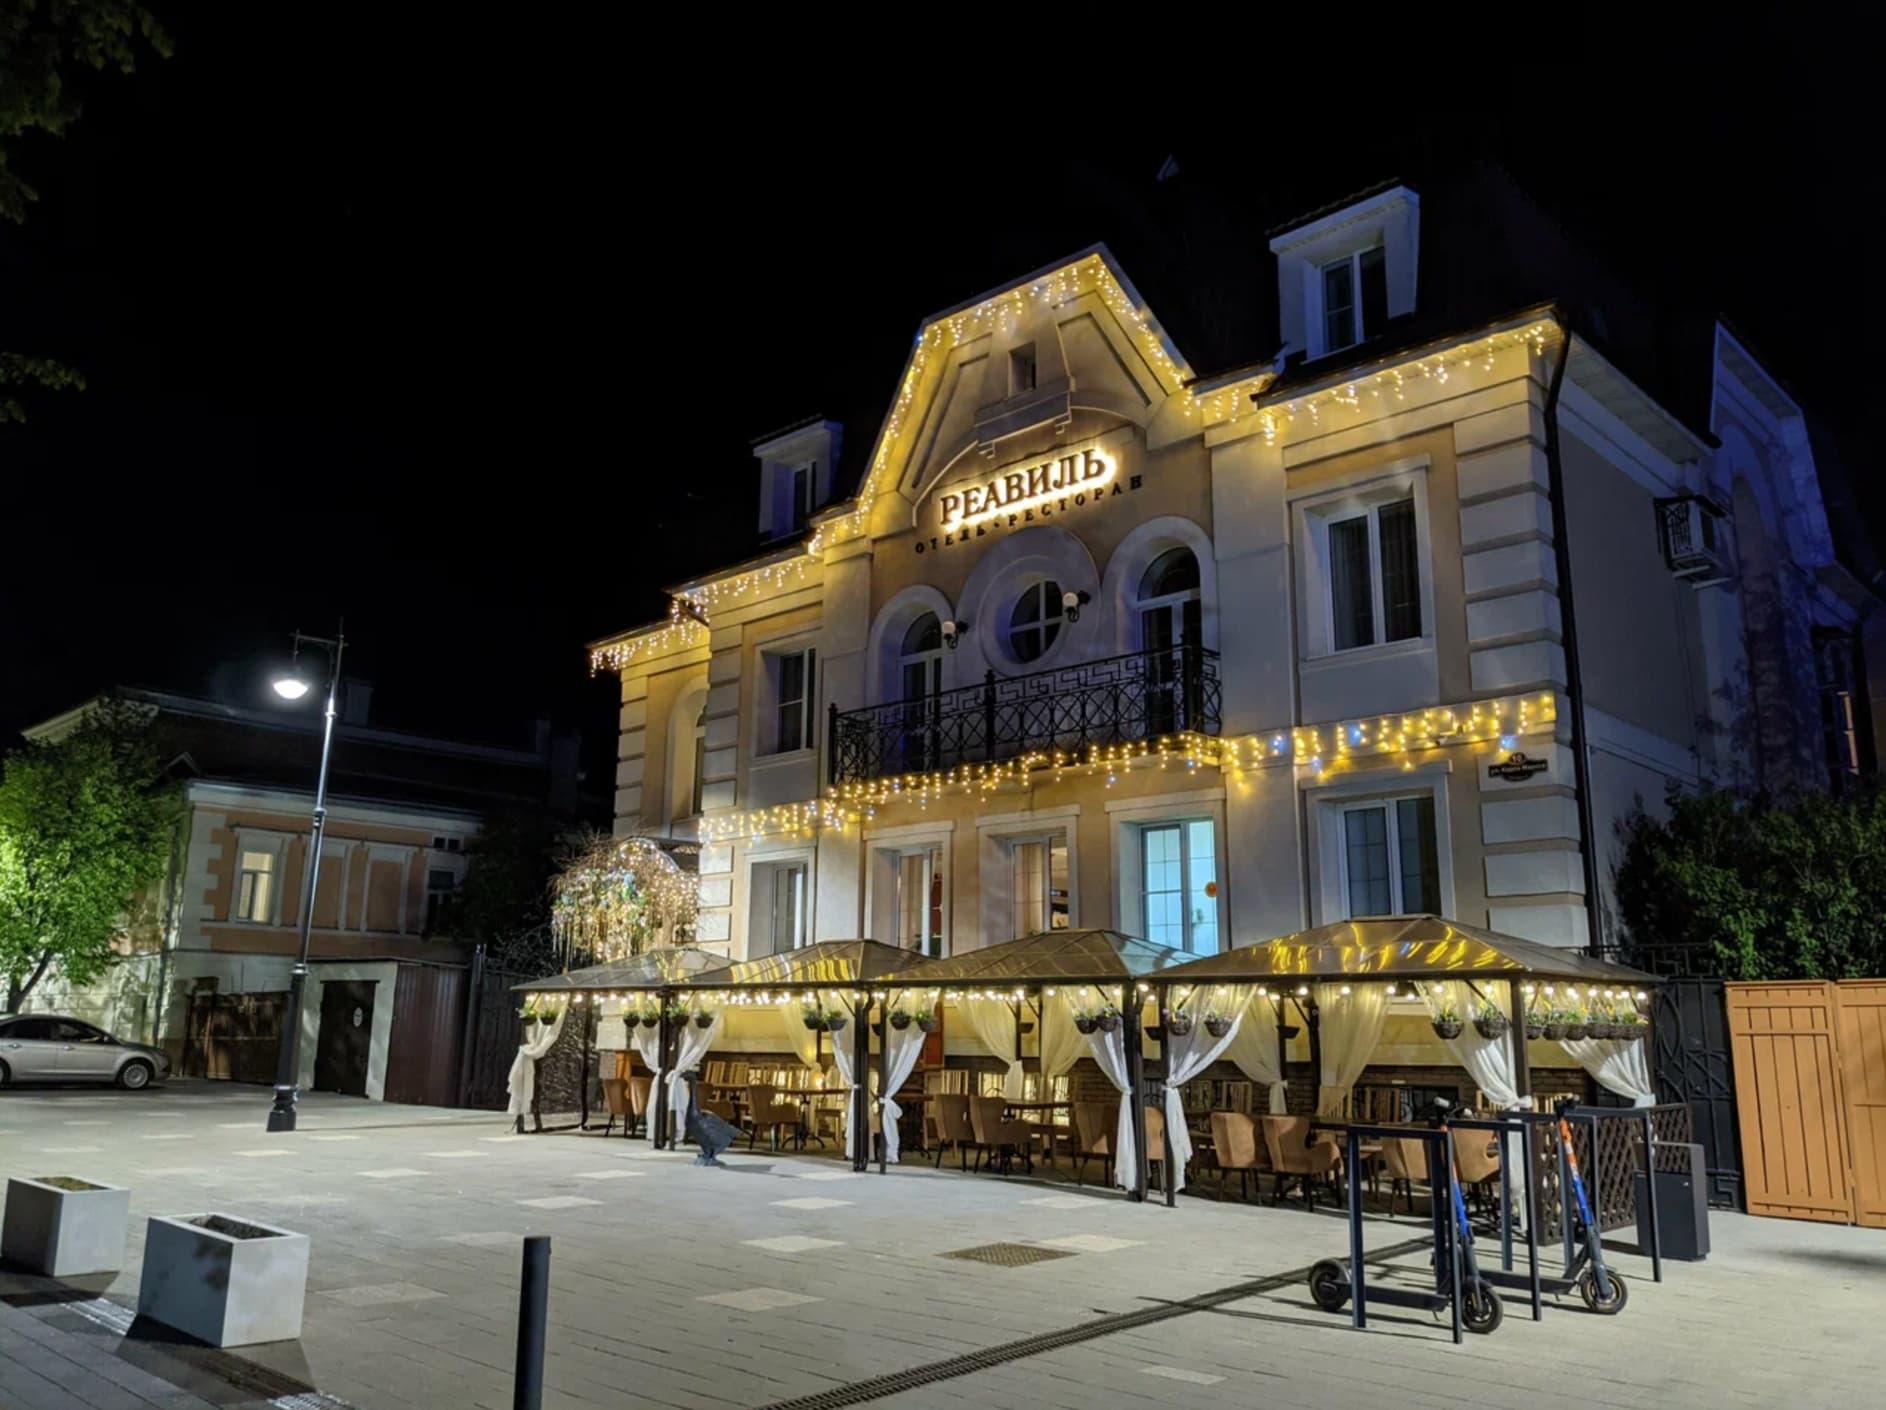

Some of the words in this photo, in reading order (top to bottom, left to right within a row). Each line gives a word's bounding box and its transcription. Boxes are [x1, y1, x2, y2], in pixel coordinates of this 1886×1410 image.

[914, 525, 986, 554] ОТЕЛЬ
[1008, 474, 1143, 527] РЕСТОРАН
[940, 448, 1106, 525] РЕАВИЛЬ
